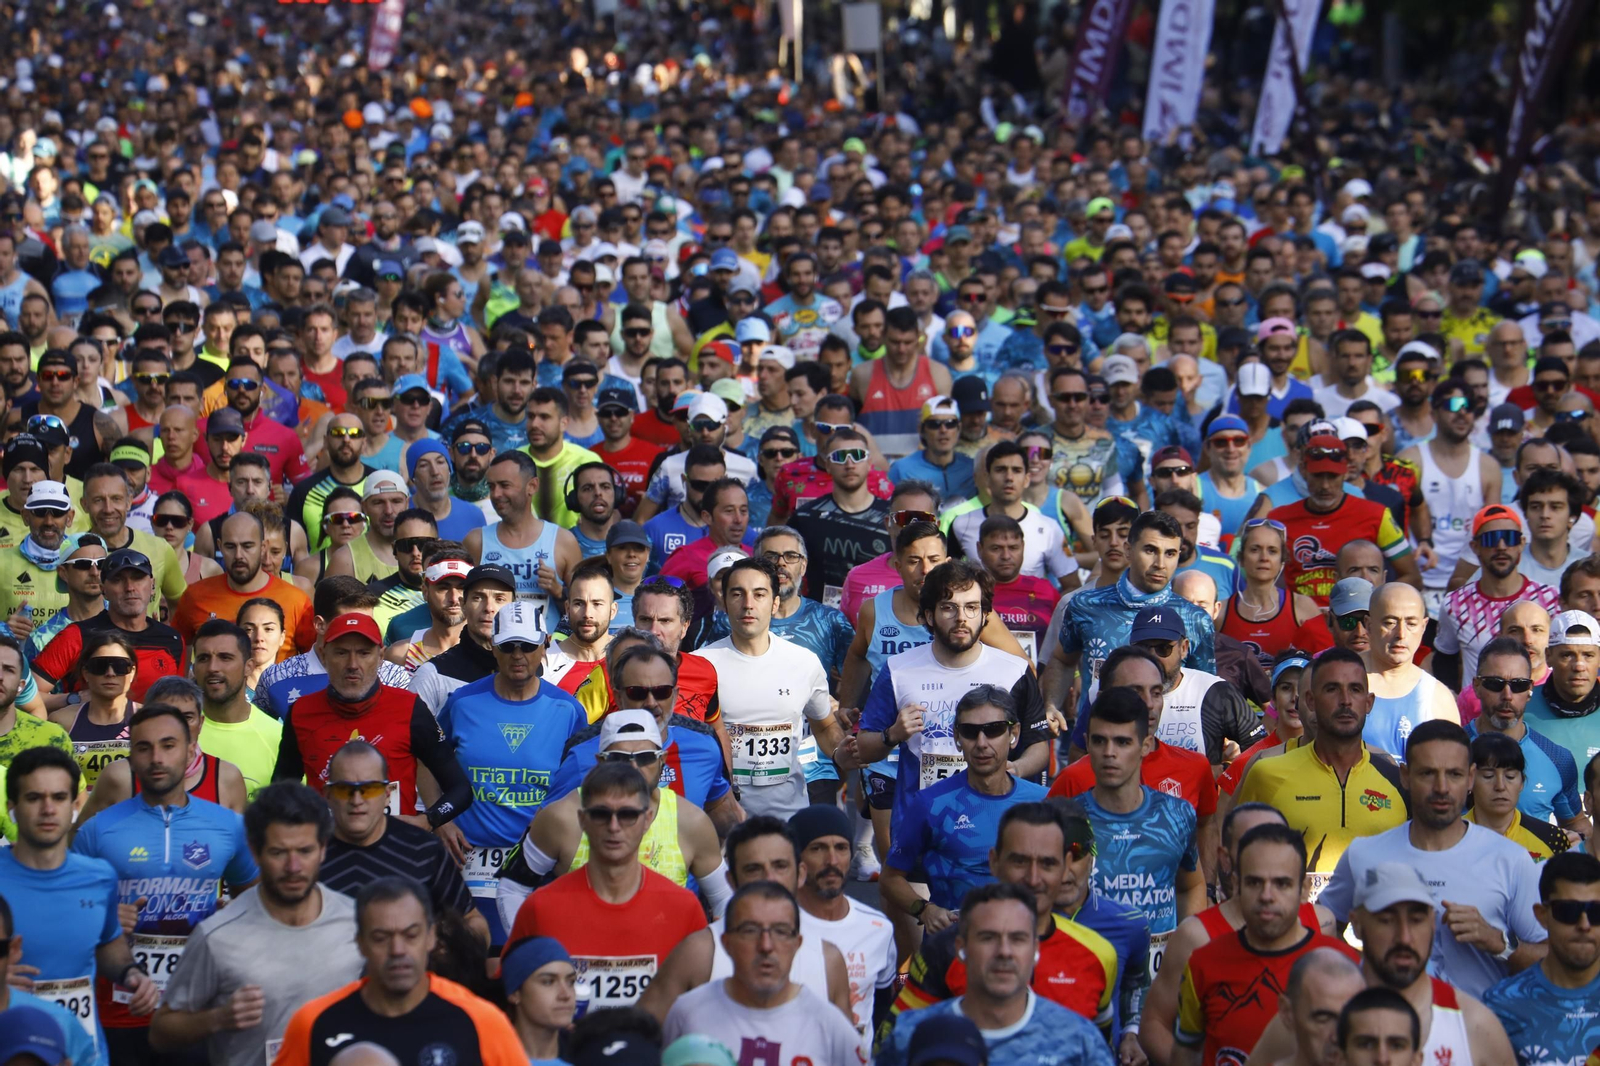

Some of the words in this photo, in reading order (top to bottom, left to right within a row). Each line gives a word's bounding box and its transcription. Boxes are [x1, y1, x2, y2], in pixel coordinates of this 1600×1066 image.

[863, 585, 886, 594] ABB
[745, 736, 790, 757] 1333
[87, 754, 126, 773] 40
[1104, 872, 1156, 891] MEDIA
[590, 975, 652, 999] 1259
